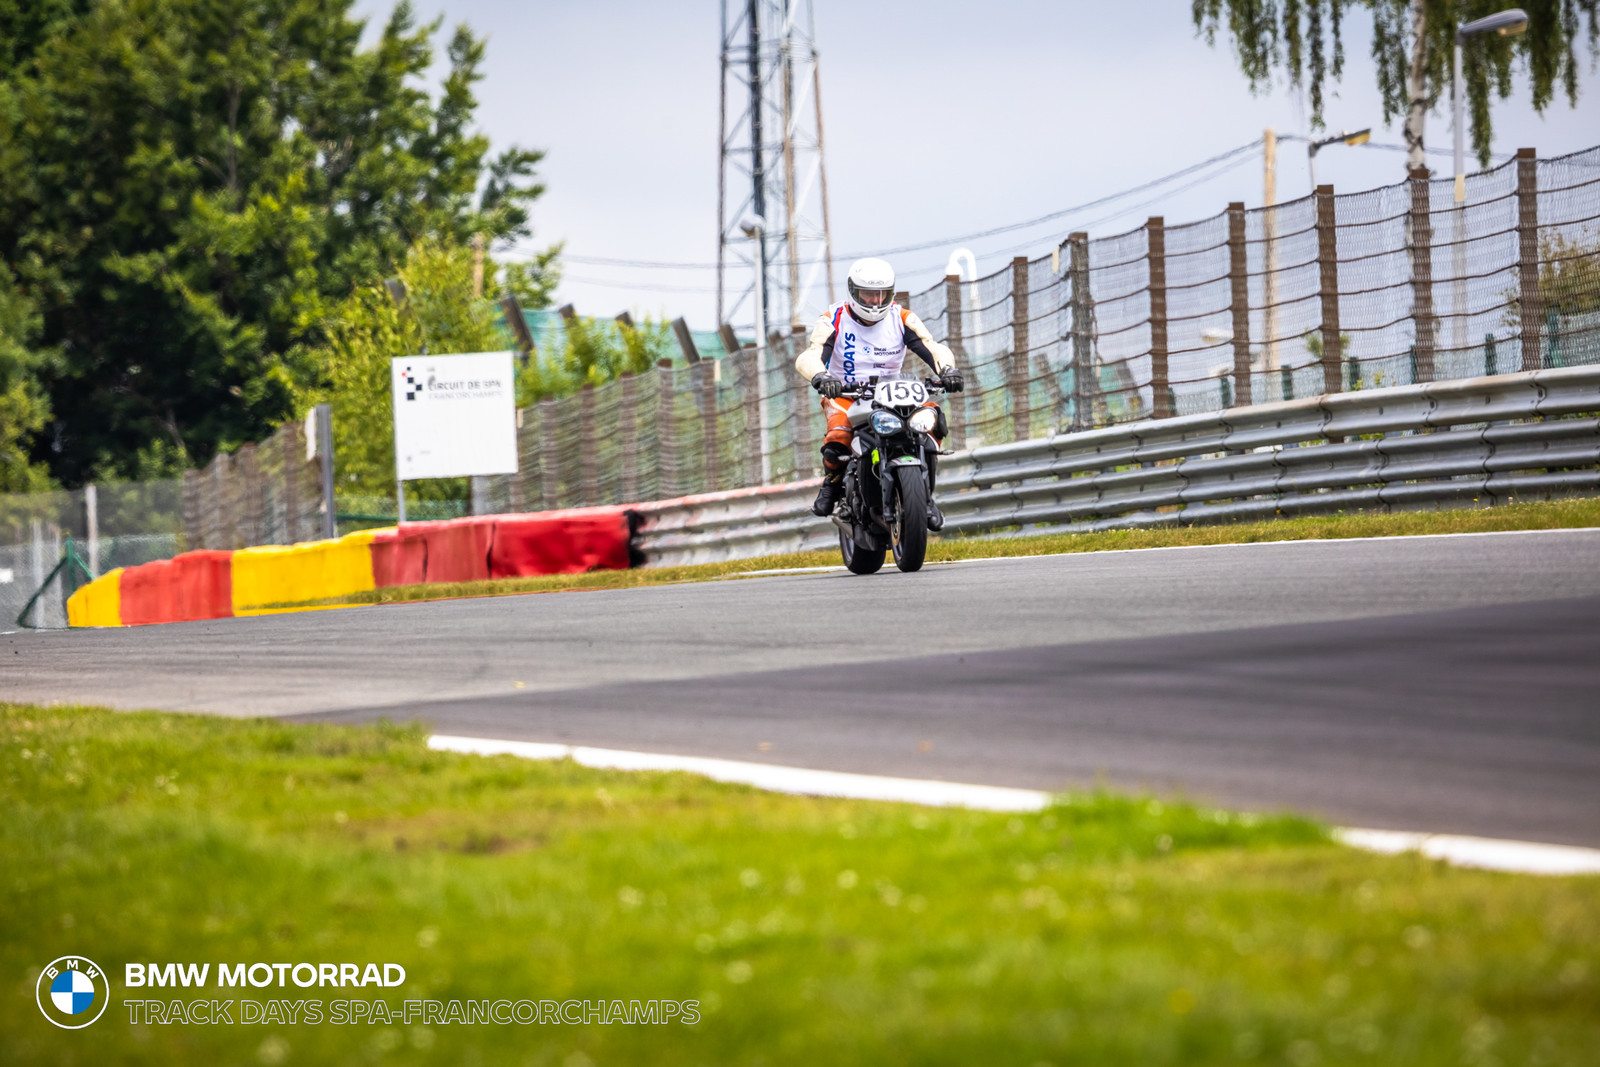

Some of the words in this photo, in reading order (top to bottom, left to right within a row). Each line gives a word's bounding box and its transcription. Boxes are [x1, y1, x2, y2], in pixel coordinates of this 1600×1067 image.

[428, 377, 465, 391] CIRCUIT
[467, 381, 481, 390] DE
[881, 382, 925, 403] 159
